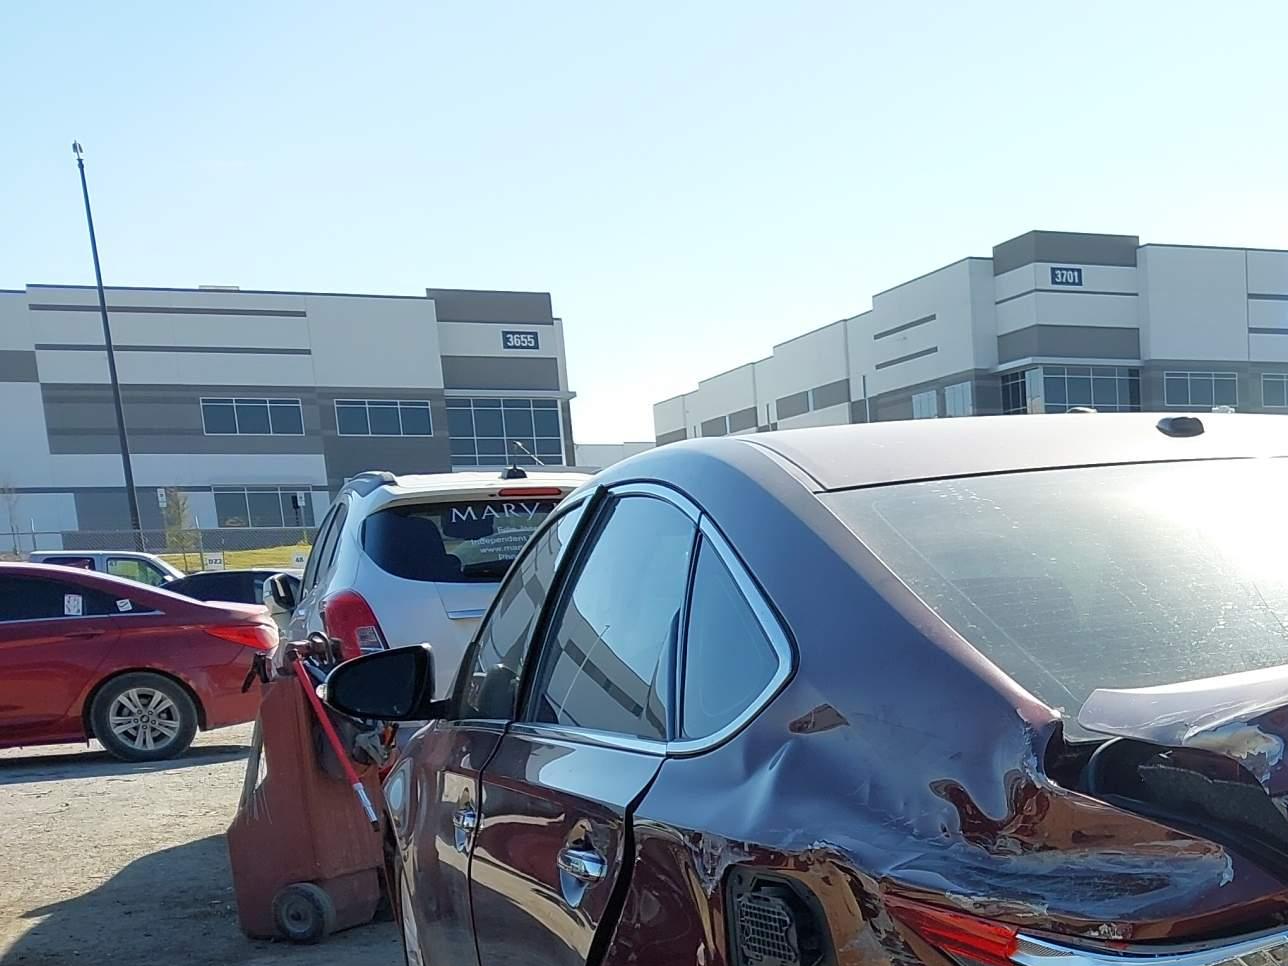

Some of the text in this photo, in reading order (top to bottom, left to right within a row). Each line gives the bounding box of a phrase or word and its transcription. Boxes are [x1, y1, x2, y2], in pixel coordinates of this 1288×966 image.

[1055, 270, 1079, 283] 3701
[506, 334, 535, 347] 3655
[451, 502, 540, 523] MARY
